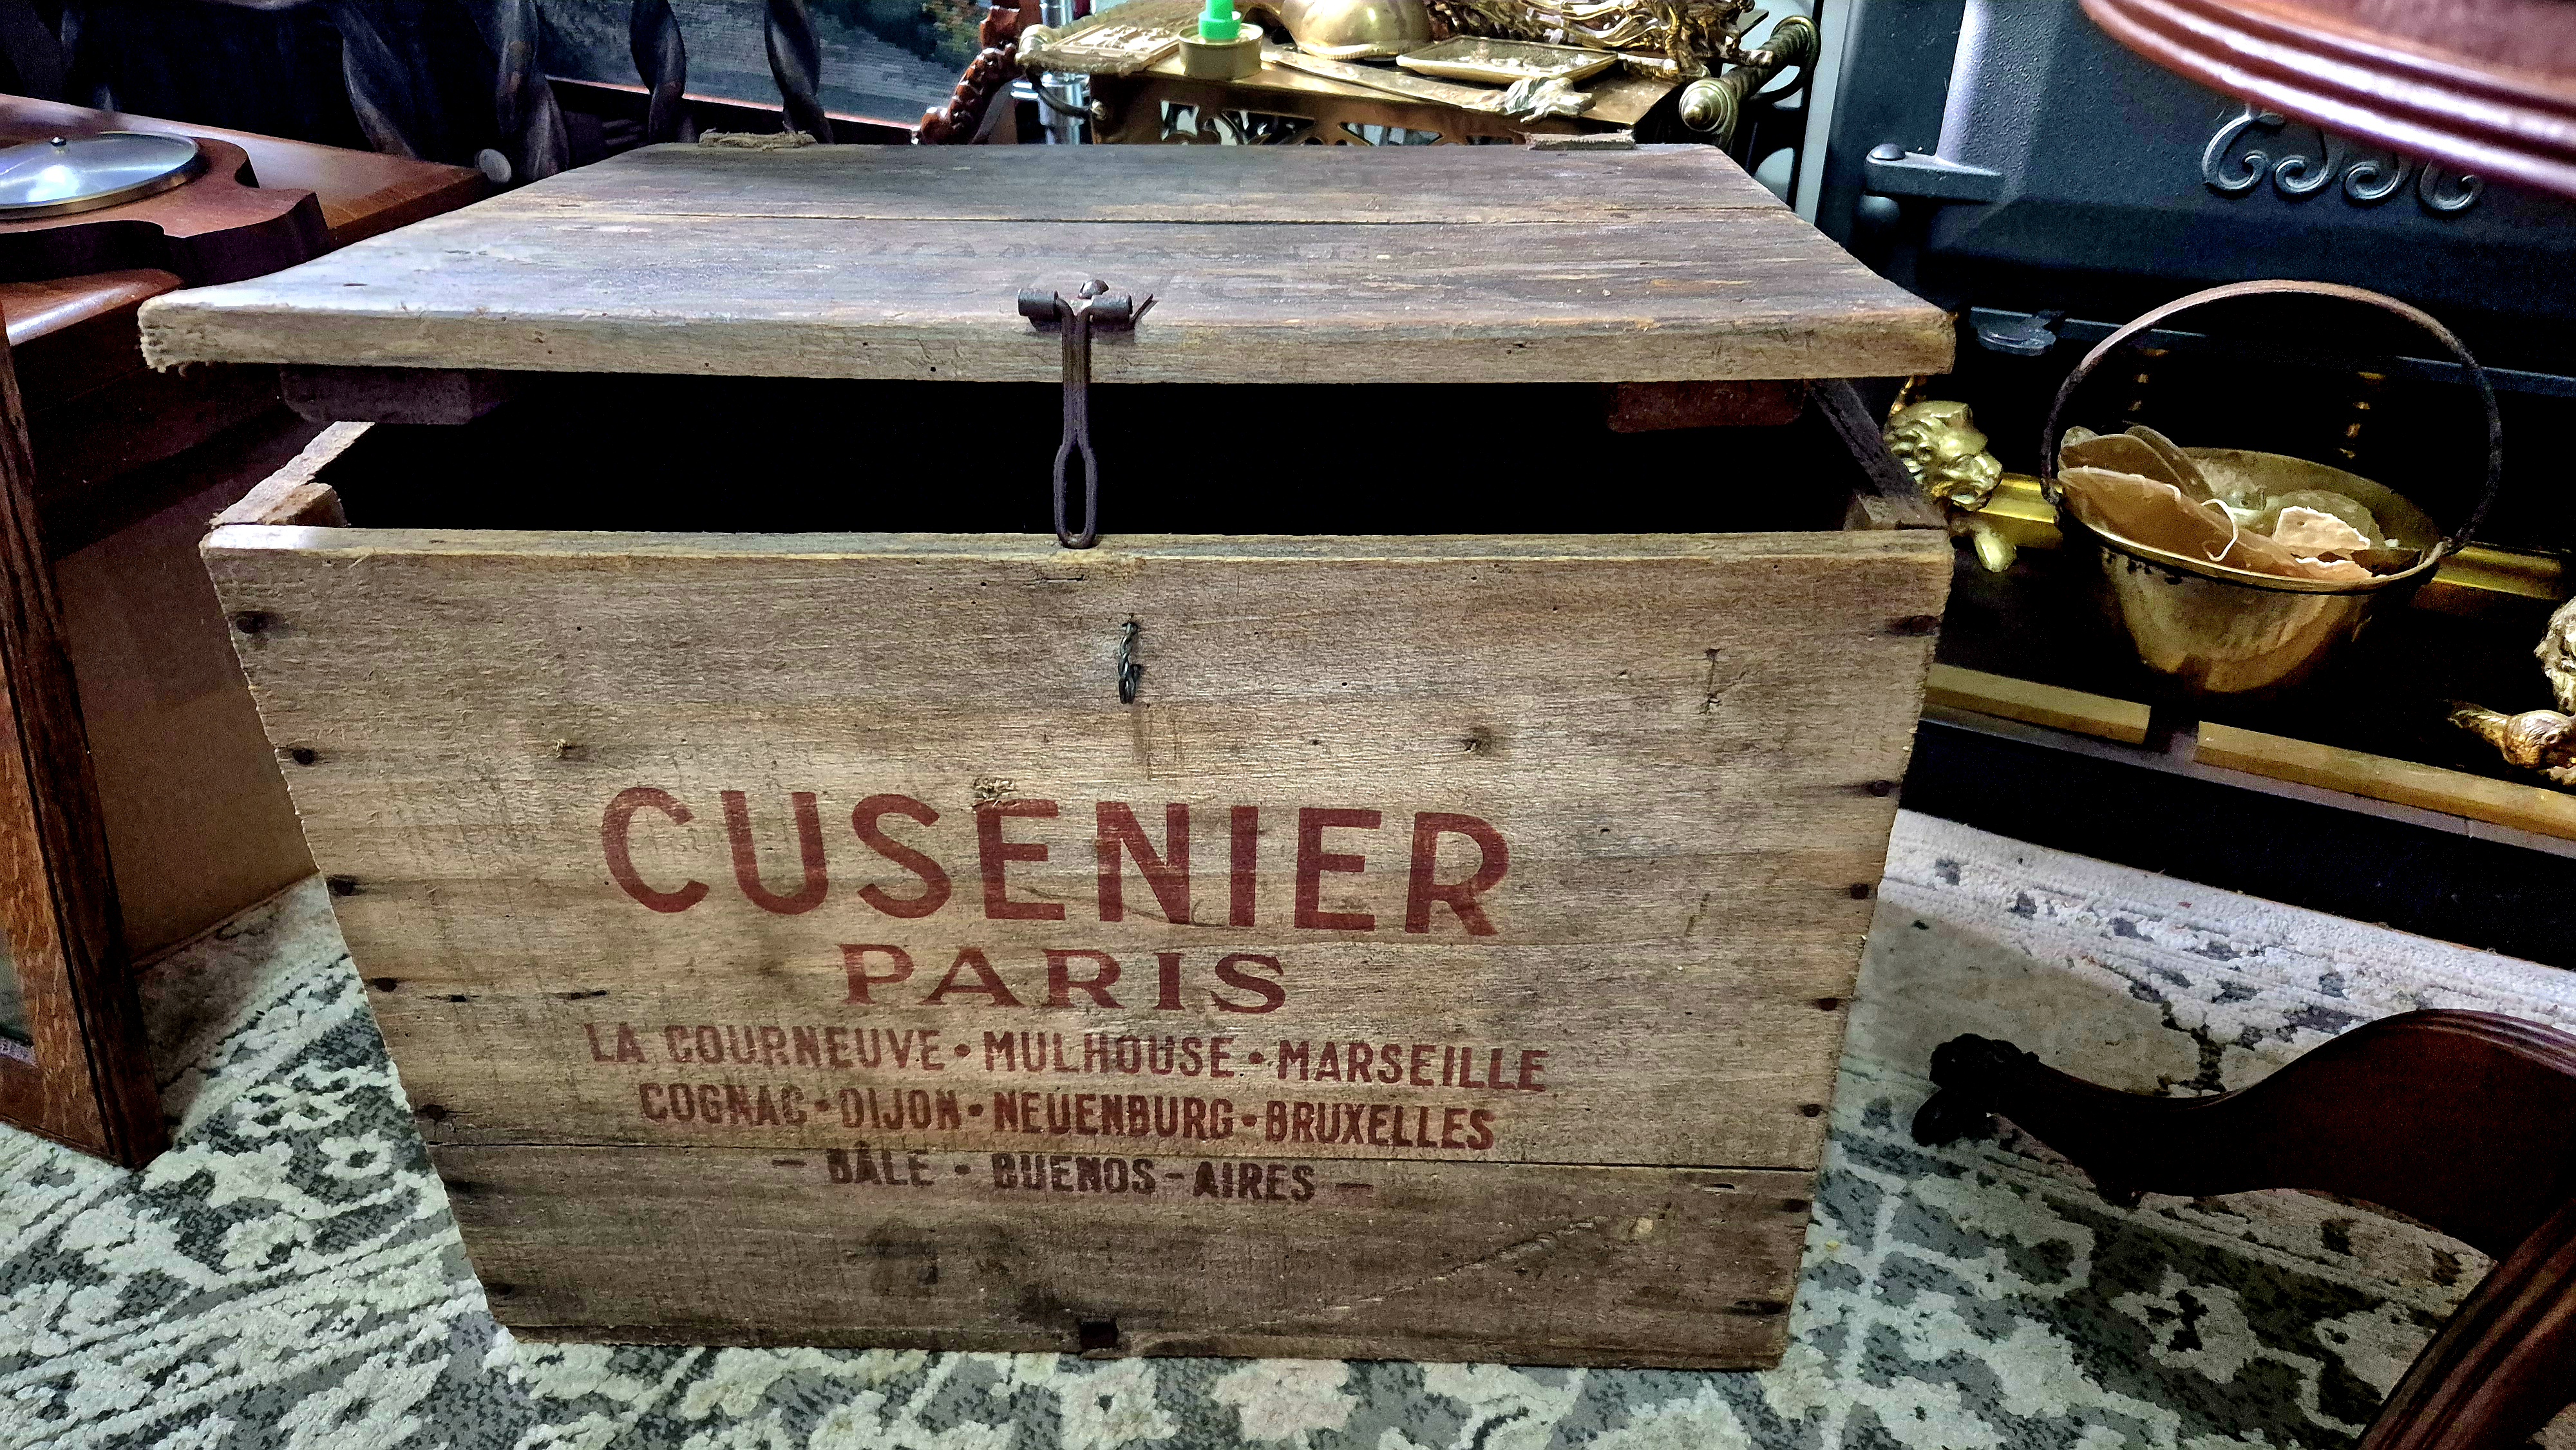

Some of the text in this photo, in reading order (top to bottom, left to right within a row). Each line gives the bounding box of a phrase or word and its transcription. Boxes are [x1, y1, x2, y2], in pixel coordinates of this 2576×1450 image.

[600, 787, 1510, 937] CUSENIER
[836, 943, 1287, 1014] PARIS
[583, 1022, 1548, 1092] LA COURNEUVE MULHOUSE MARSEILLE
[639, 1082, 1495, 1151] COGNAC DIJON NEUENBURG BRUXELLES
